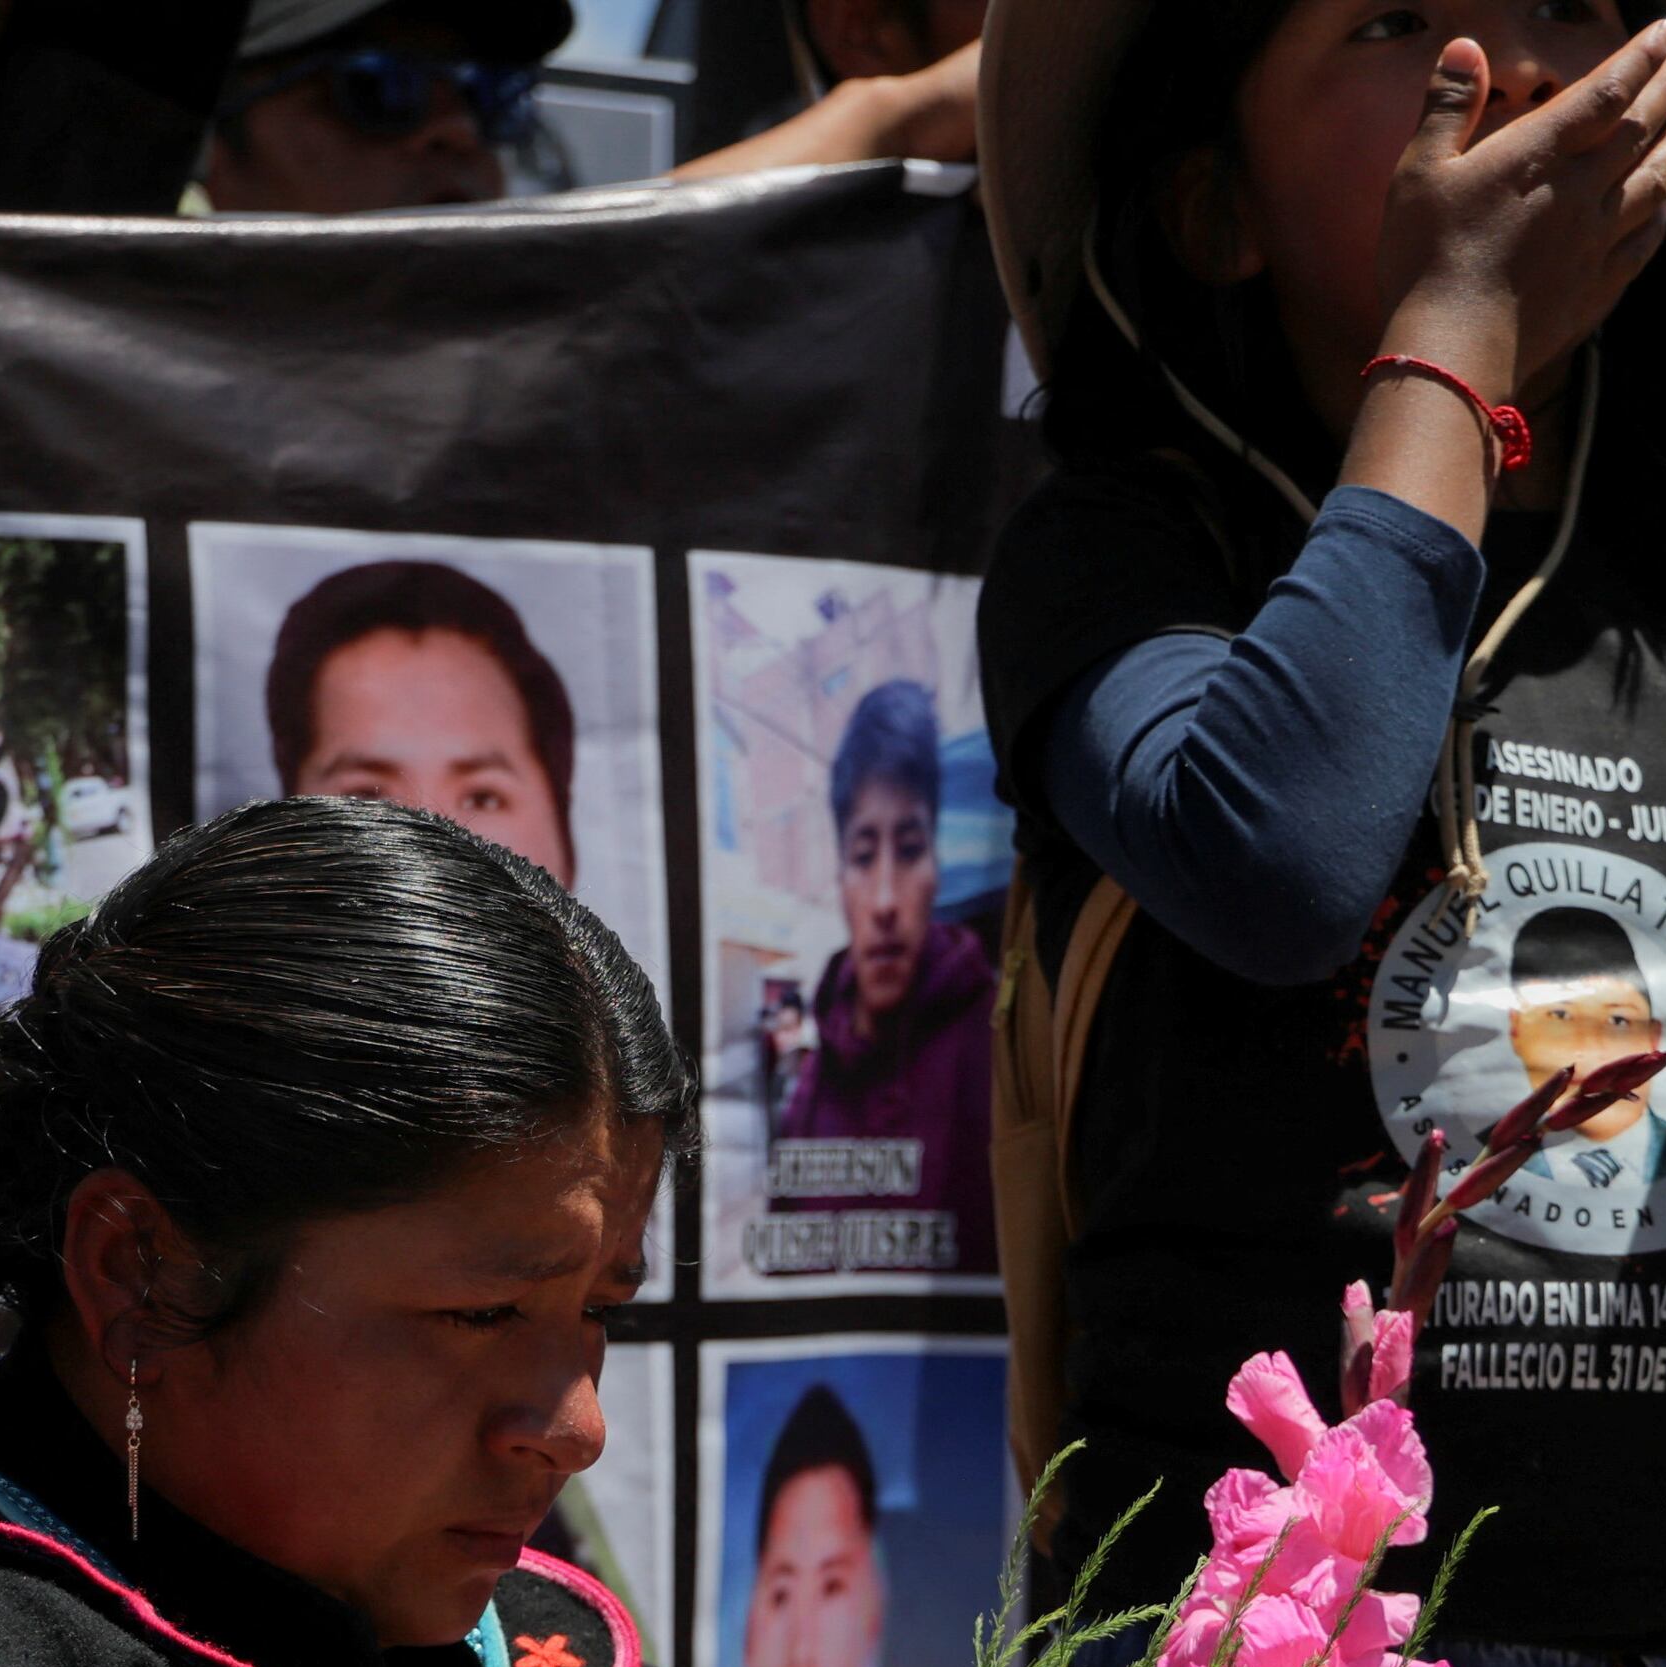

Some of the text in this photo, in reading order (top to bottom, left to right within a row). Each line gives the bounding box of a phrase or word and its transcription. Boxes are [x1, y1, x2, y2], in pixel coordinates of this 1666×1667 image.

[1486, 739, 1642, 793] ASESINADO
[1474, 783, 1511, 825] DE
[1514, 787, 1605, 838] ENERO
[1507, 858, 1642, 915] QUILLA
[1612, 1206, 1653, 1229] EN
[1543, 1281, 1579, 1327] EN
[1584, 1281, 1646, 1328] LIMA
[1441, 1342, 1567, 1391] FALLECIO
[1570, 1343, 1602, 1391] EL
[1606, 1344, 1633, 1392] 31
